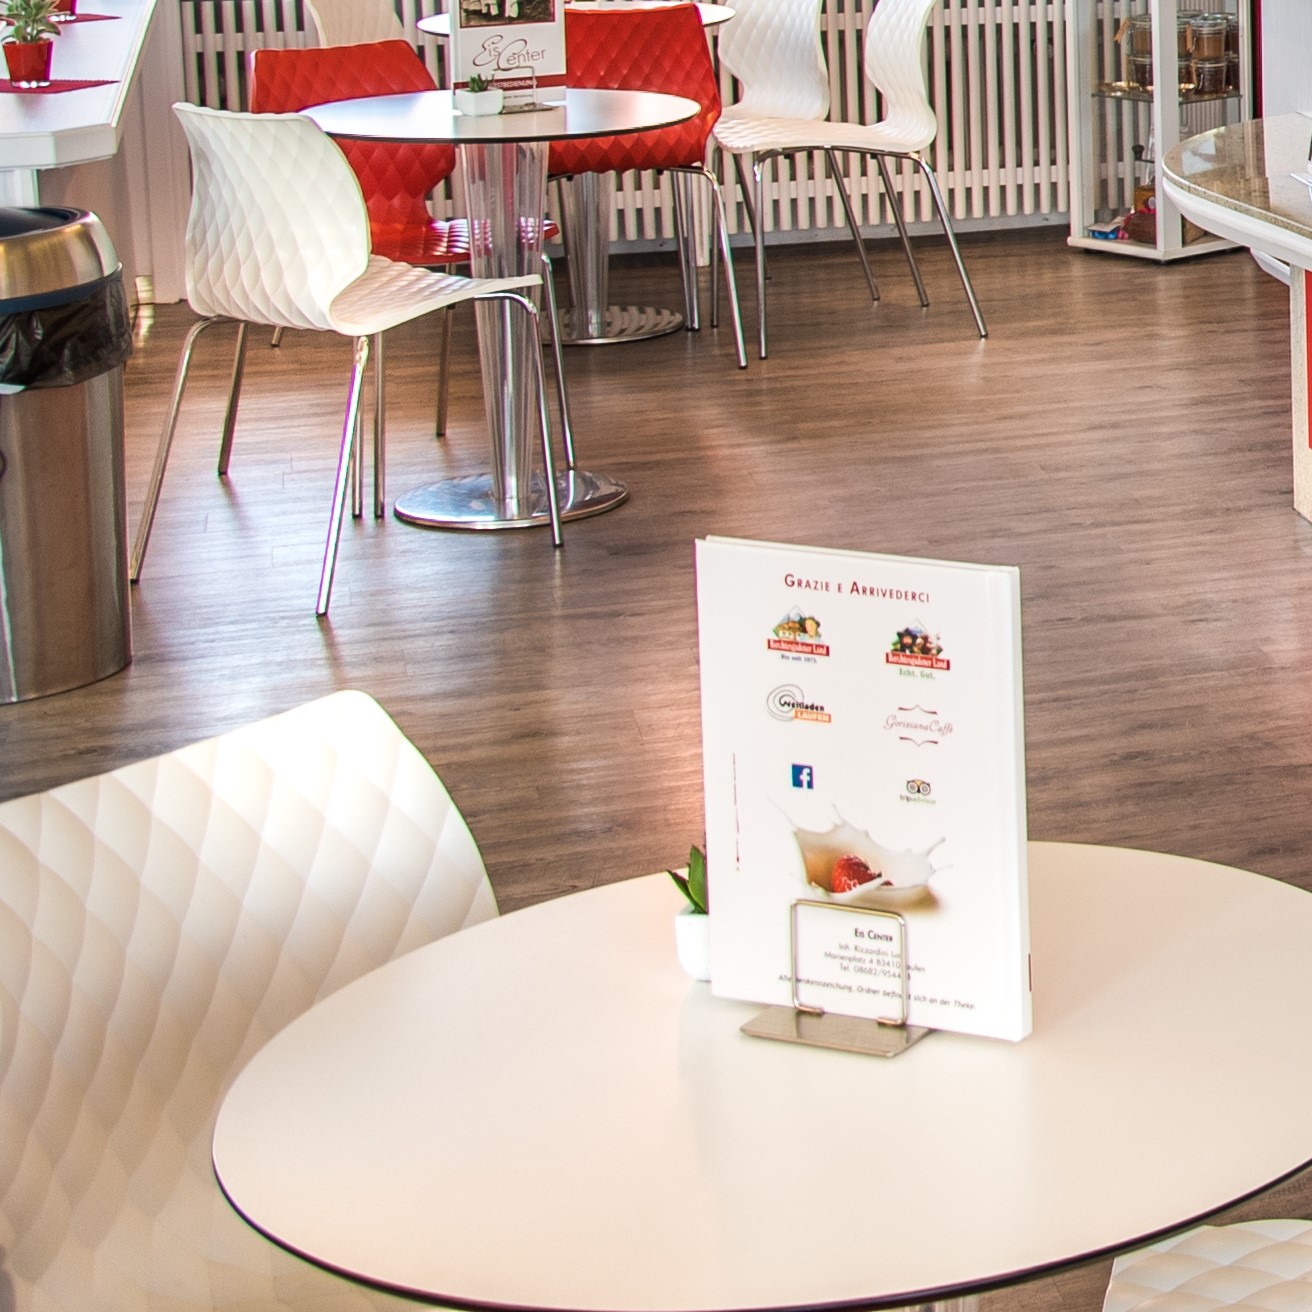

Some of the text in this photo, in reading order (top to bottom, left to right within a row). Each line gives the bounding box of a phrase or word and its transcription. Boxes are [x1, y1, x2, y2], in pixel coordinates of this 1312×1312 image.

[497, 39, 546, 71] Center
[784, 574, 830, 592] GRAZIE
[850, 581, 929, 602] ARRIVEDERCI
